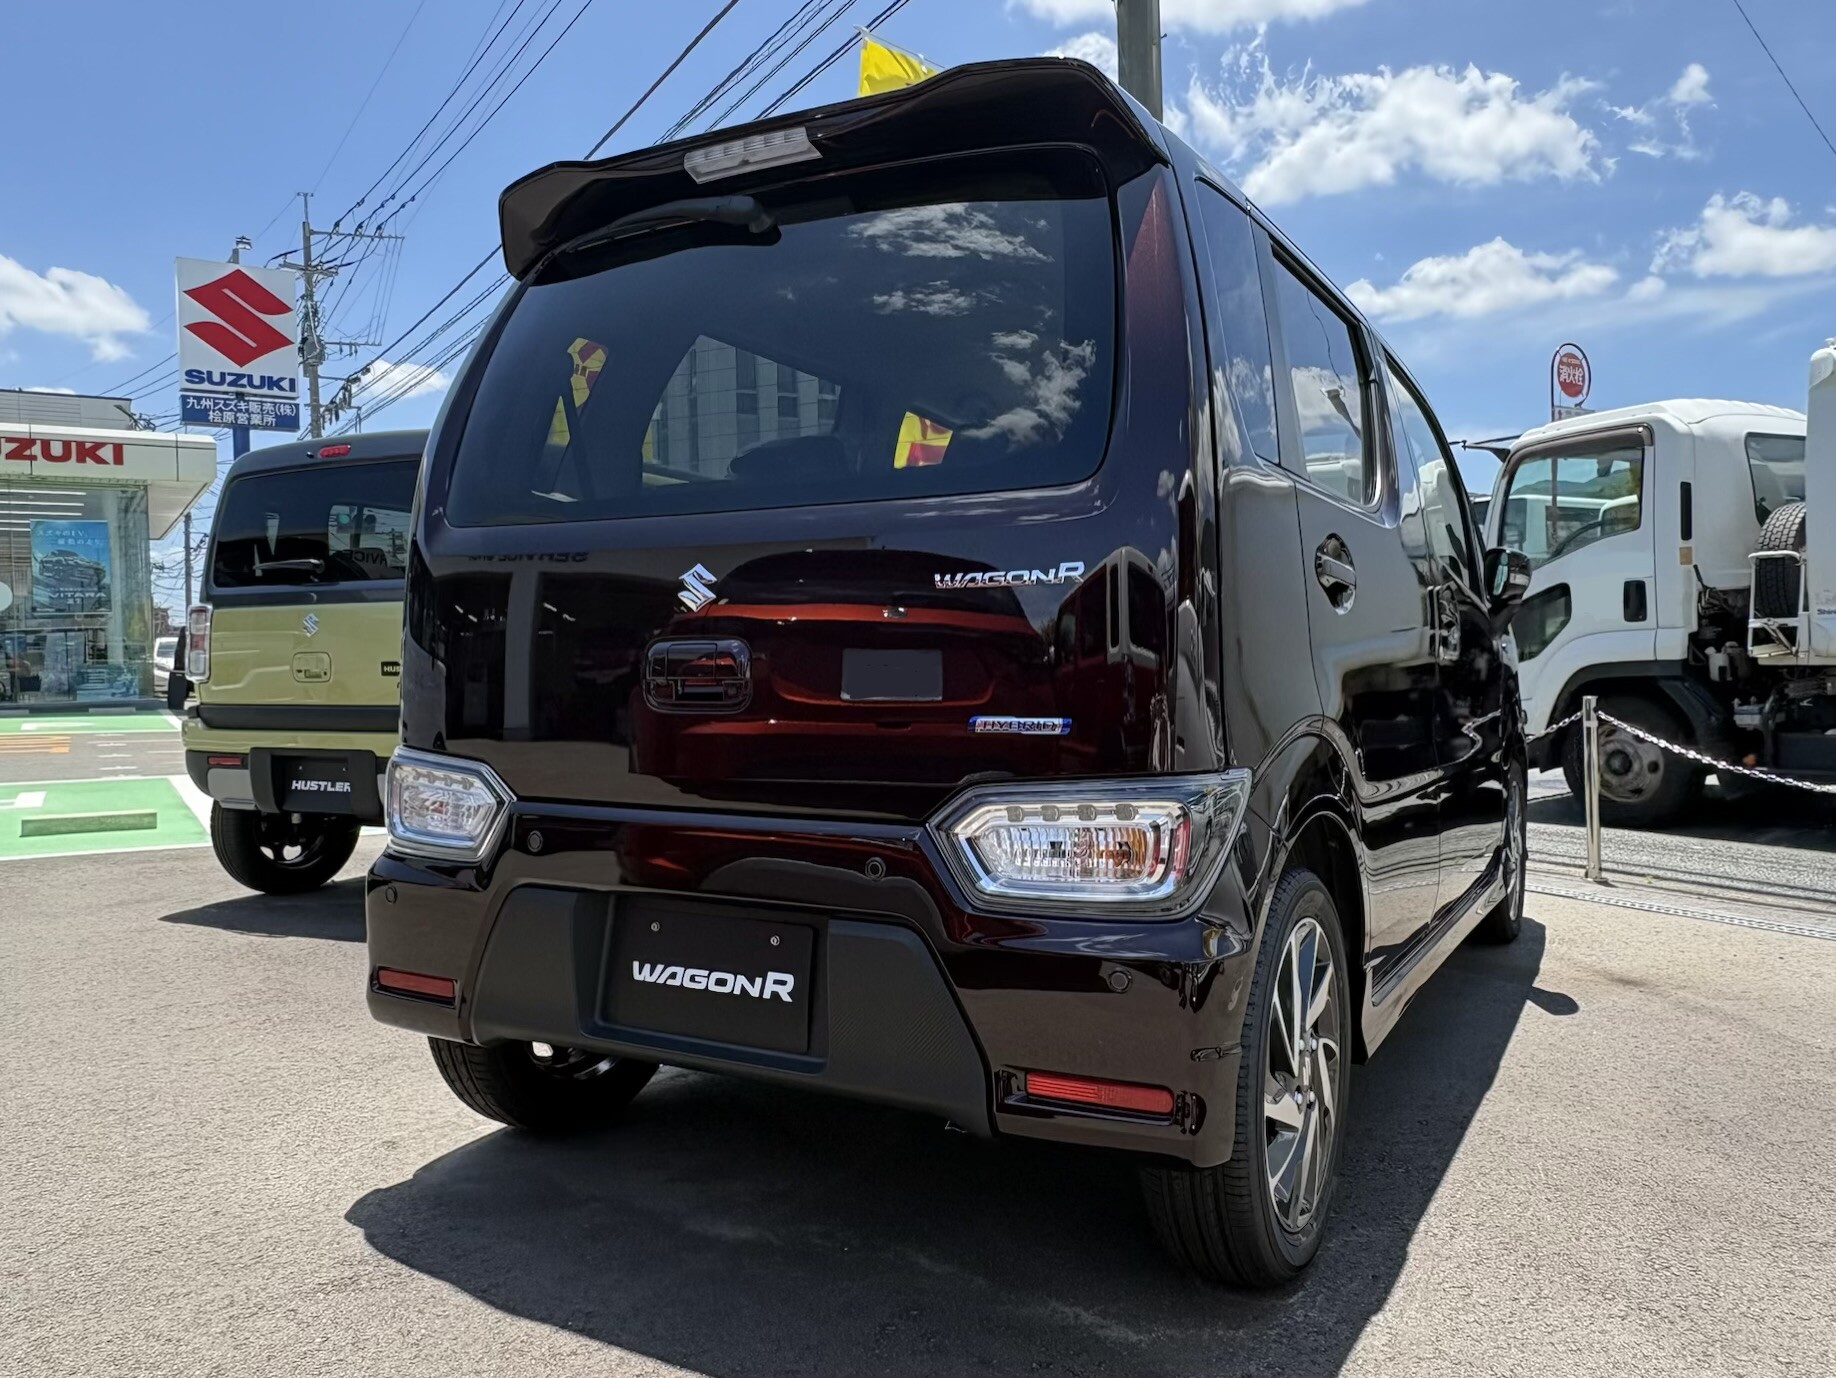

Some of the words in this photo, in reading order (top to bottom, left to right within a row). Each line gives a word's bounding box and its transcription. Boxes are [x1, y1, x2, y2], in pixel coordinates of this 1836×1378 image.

[184, 369, 296, 393] SUZUKI
[186, 397, 296, 417] 九州スズキ販売(株)
[208, 411, 277, 427] 桧原営業所
[0, 437, 124, 466] ZUKI
[291, 780, 351, 793] HUSTLER
